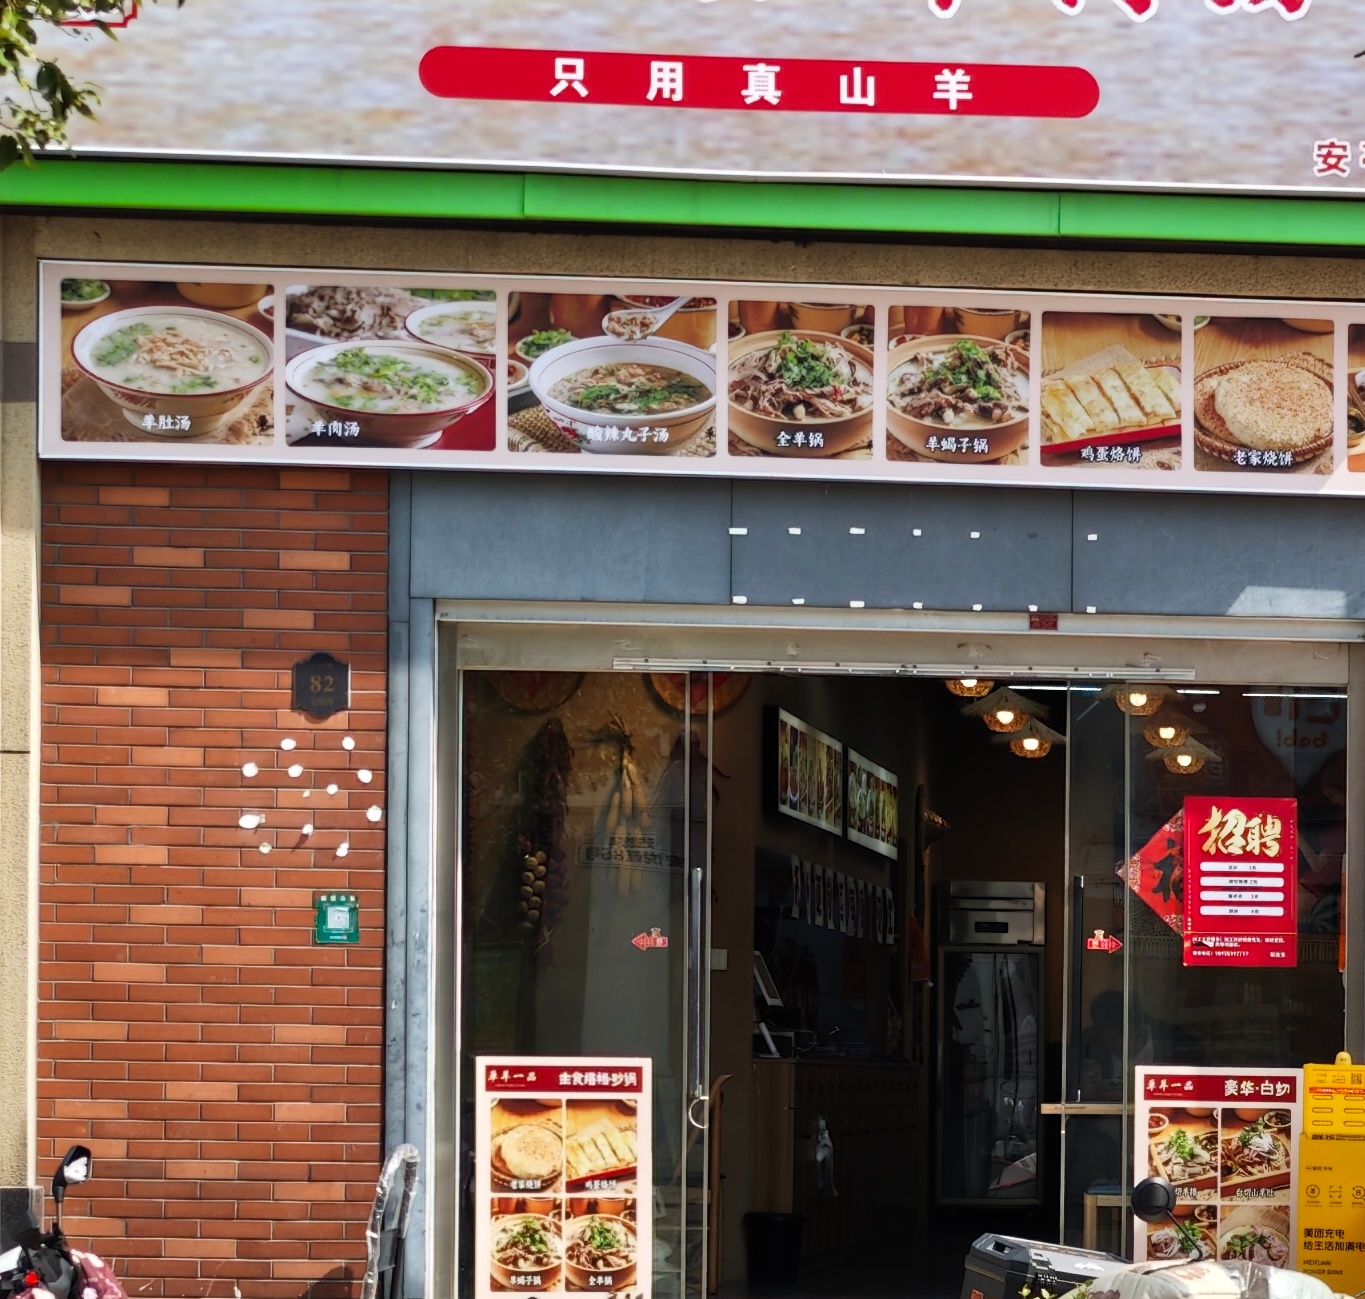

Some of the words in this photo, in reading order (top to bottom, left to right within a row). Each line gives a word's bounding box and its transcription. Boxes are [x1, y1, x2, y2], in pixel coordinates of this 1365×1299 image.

[550, 57, 973, 110] 只用真山羊
[142, 414, 191, 431] 羊肚汤
[311, 421, 360, 437] 羊肉汤
[587, 426, 669, 444] 酸辣丸子汤
[776, 431, 824, 448] 全羊锅
[926, 436, 988, 454] 羊蝎子锅
[1081, 446, 1142, 463] 鸡蛋烙饼
[1234, 448, 1293, 466] 老家烧饼
[310, 675, 334, 692] 82
[1197, 805, 1282, 857] 招聘
